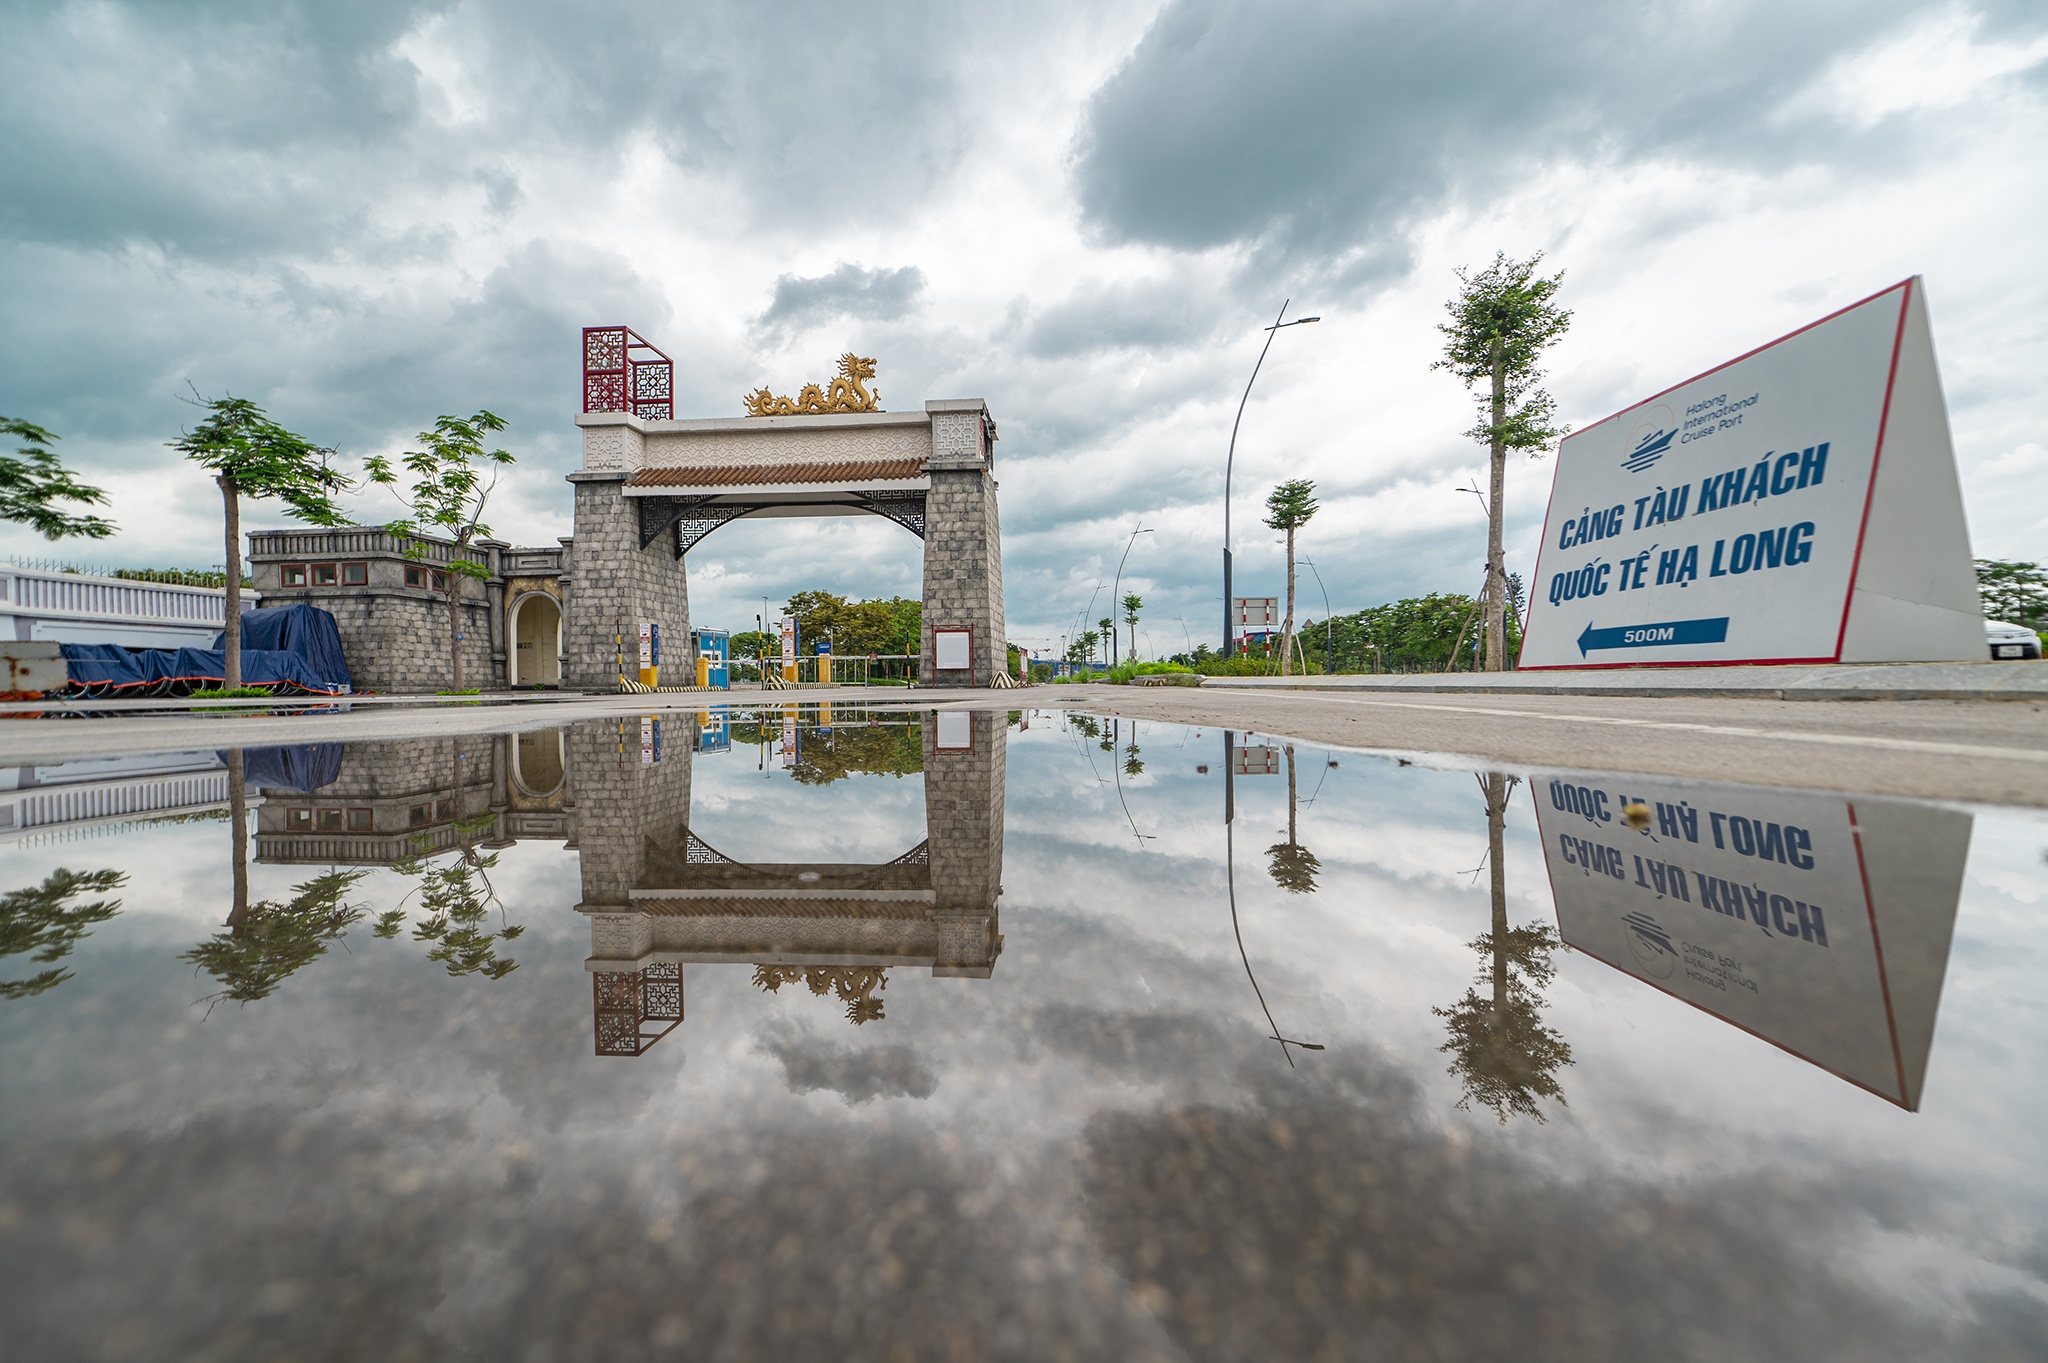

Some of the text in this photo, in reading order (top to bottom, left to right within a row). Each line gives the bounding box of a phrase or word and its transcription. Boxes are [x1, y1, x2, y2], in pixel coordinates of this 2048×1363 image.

[1683, 392, 1759, 430] International
[1686, 393, 1727, 416] Halong
[1680, 414, 1743, 444] Cruise Port
[1559, 442, 1831, 550] CẢNG TÀU KHÁCH
[1549, 521, 1816, 607] QUỐC TẾ HẠ LONG
[1624, 627, 1675, 643] 500M
